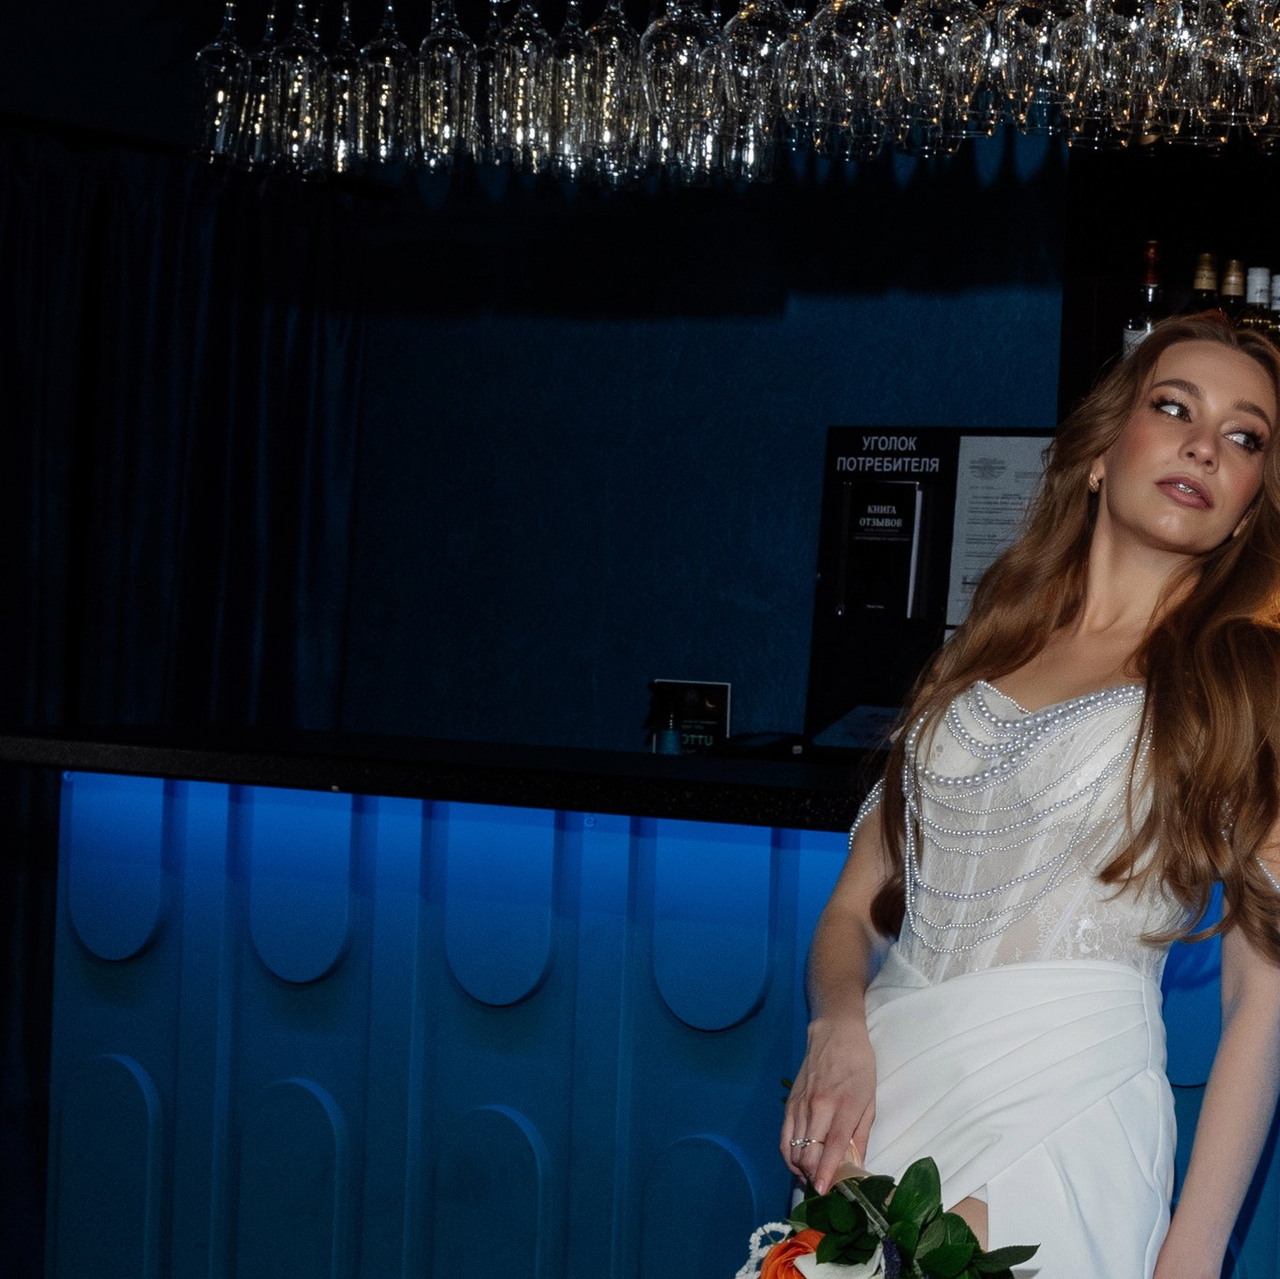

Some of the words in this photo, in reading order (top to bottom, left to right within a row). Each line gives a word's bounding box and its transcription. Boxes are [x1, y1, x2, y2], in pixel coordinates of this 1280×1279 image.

[862, 436, 918, 451] УГОЛОК
[836, 456, 940, 473] ПОТРЕБИТЕЛЯ
[867, 504, 897, 515] КНИГА
[859, 517, 903, 528] ОТЗЫВОВ
